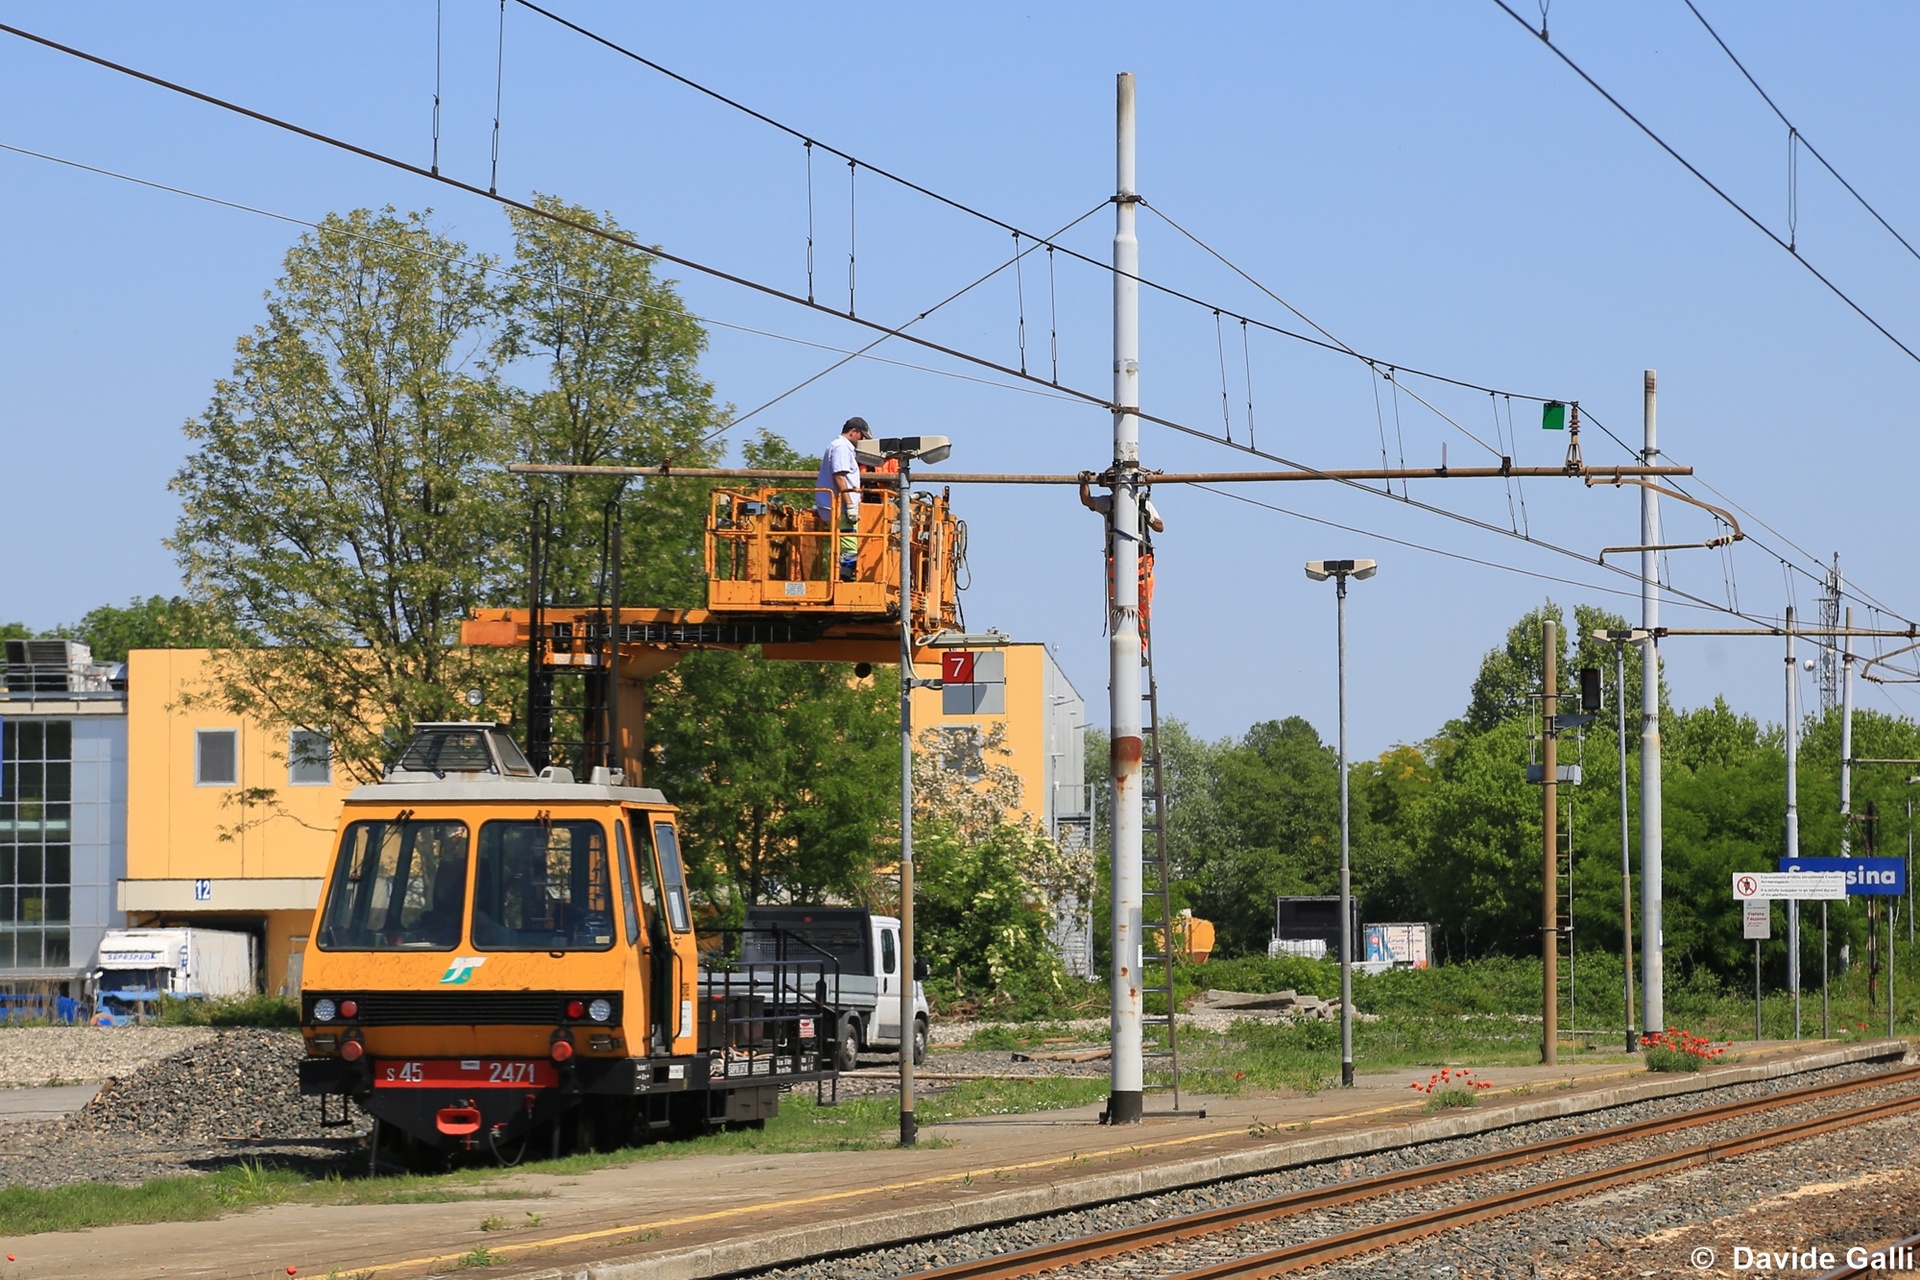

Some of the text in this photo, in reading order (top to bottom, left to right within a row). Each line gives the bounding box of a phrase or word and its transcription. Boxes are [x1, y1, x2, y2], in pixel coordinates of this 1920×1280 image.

[950, 657, 965, 678] 7
[196, 880, 210, 900] 12
[399, 1062, 424, 1082] 45
[489, 1062, 535, 1083] 2471
